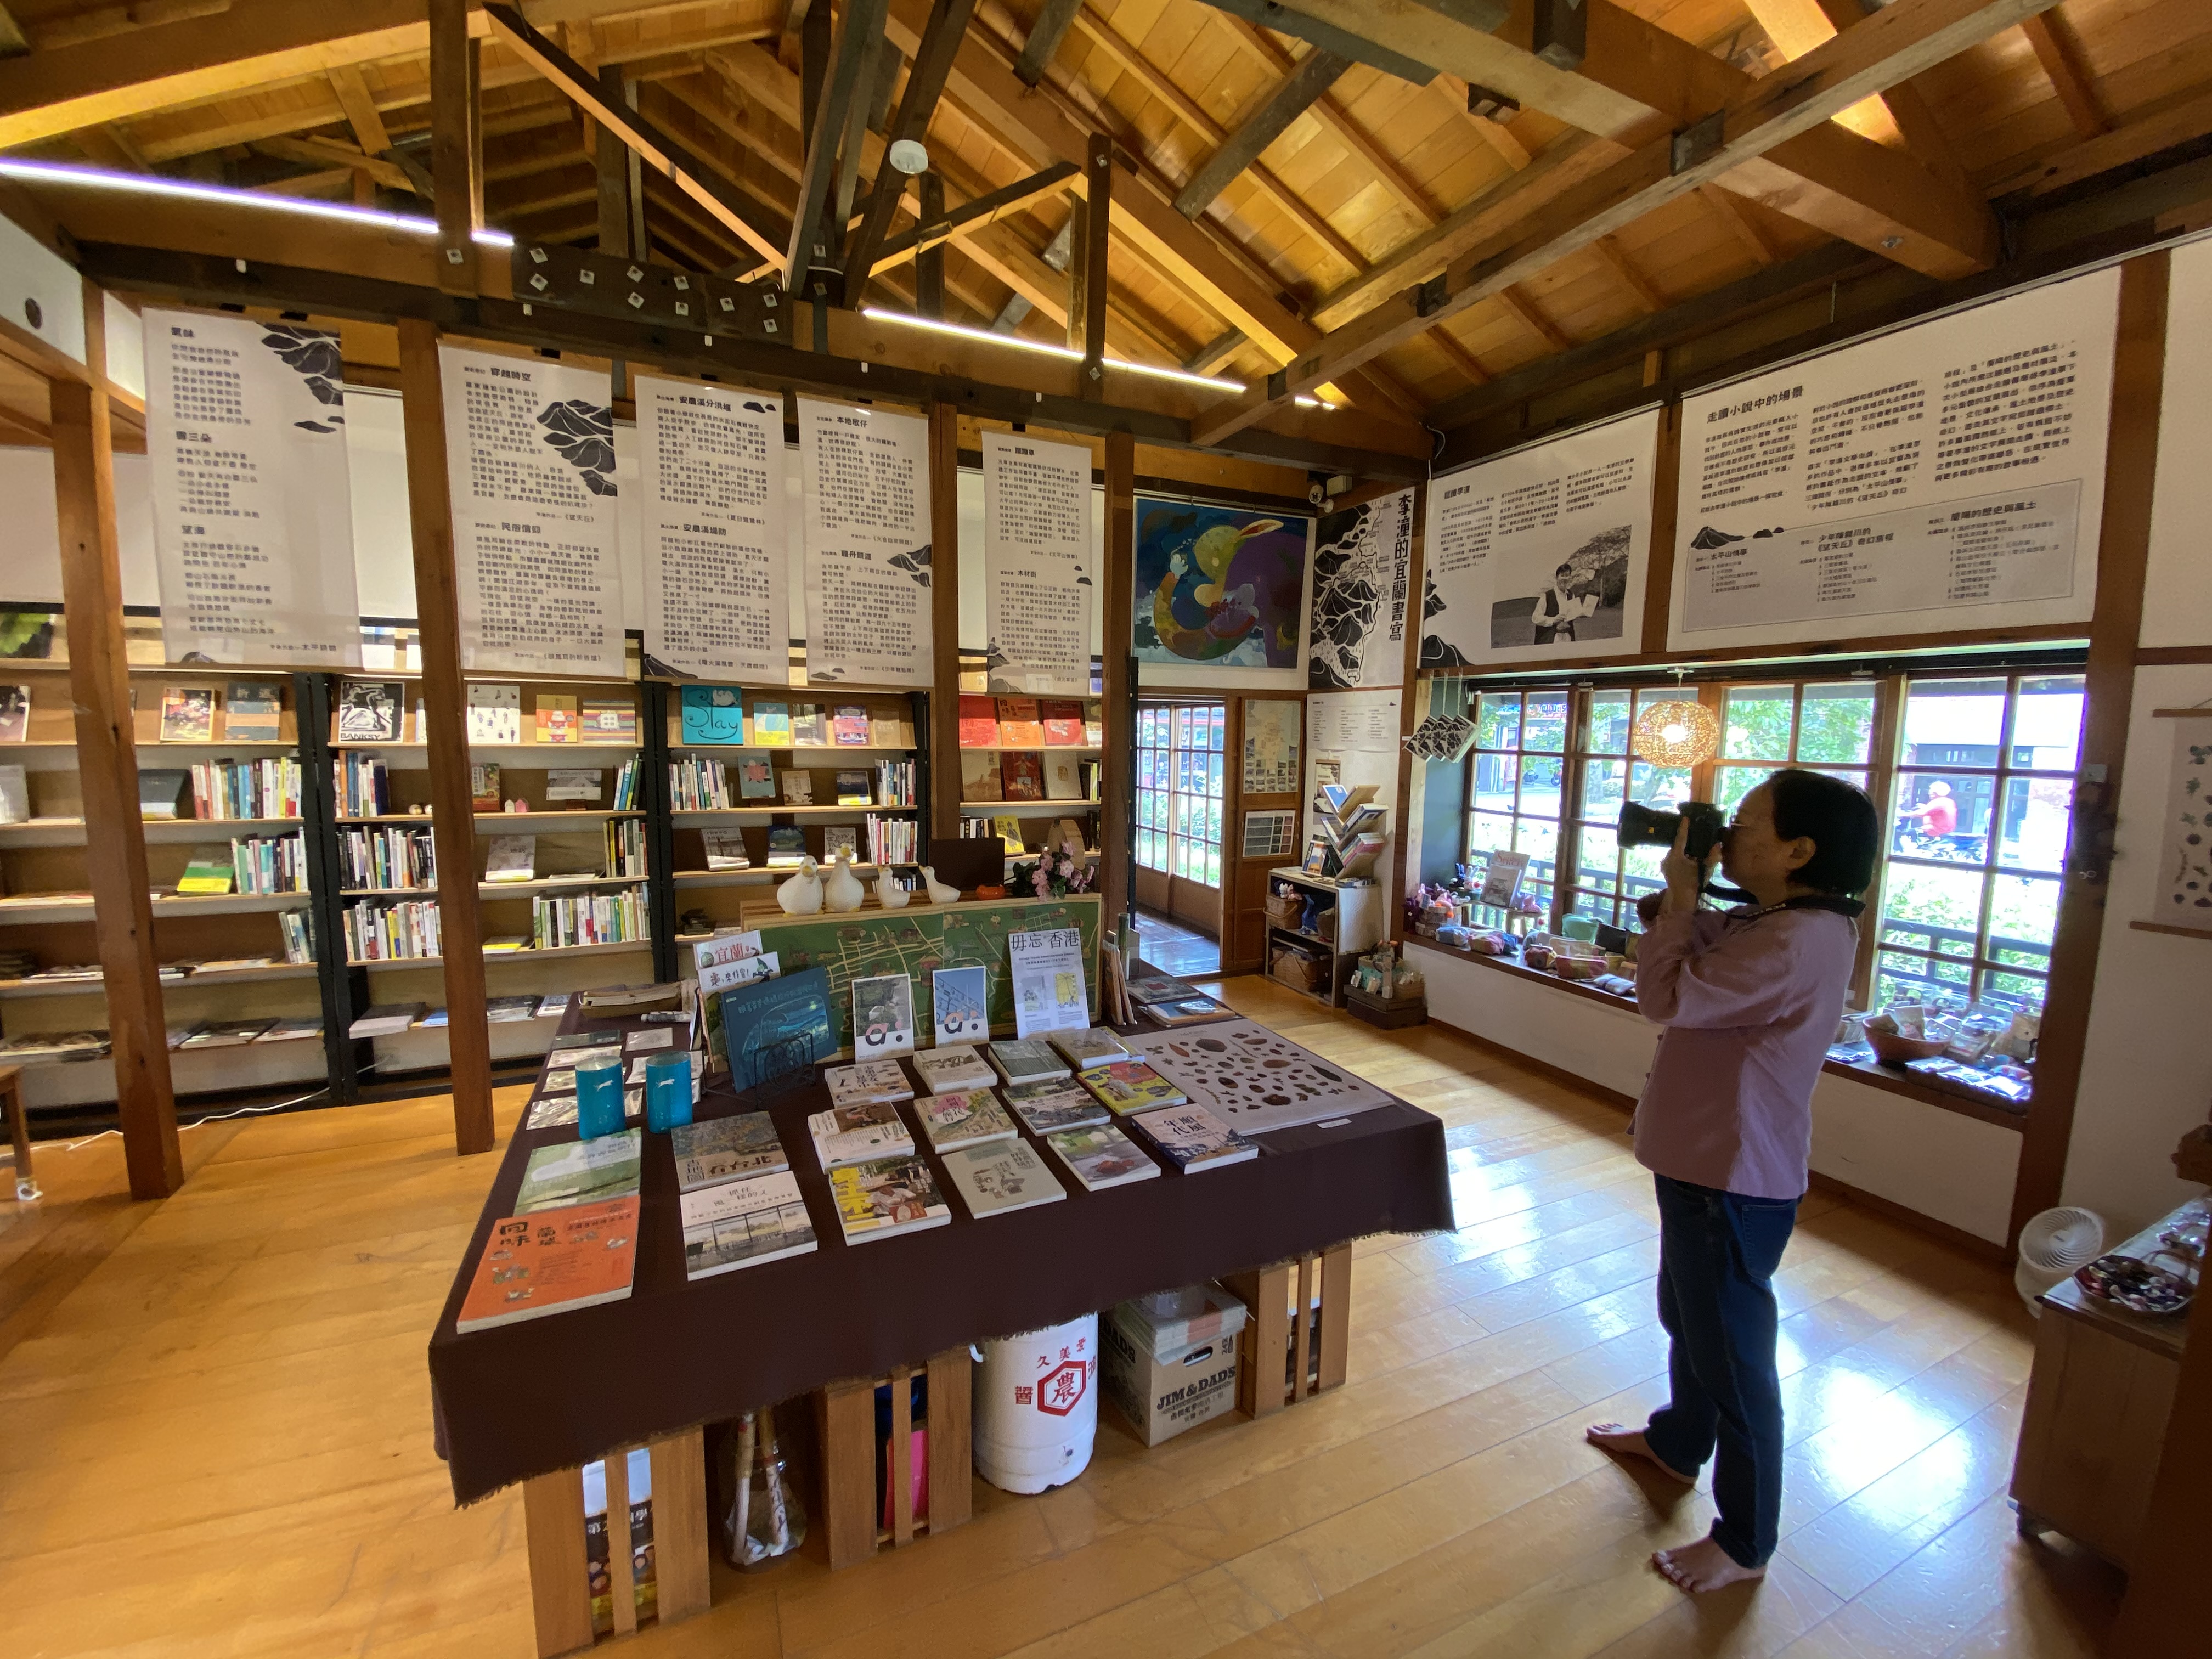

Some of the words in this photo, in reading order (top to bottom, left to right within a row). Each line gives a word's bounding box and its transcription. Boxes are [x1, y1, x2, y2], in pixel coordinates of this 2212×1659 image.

[1706, 385, 1803, 424] 走讀小說中的場景
[837, 416, 868, 428] 本地歌仔
[501, 522, 541, 534] 民俗信仰
[683, 523, 727, 536] 安農溪堤防
[1389, 494, 1412, 641] 李潼的宜蘭書寫
[715, 943, 744, 964] 宜蘭
